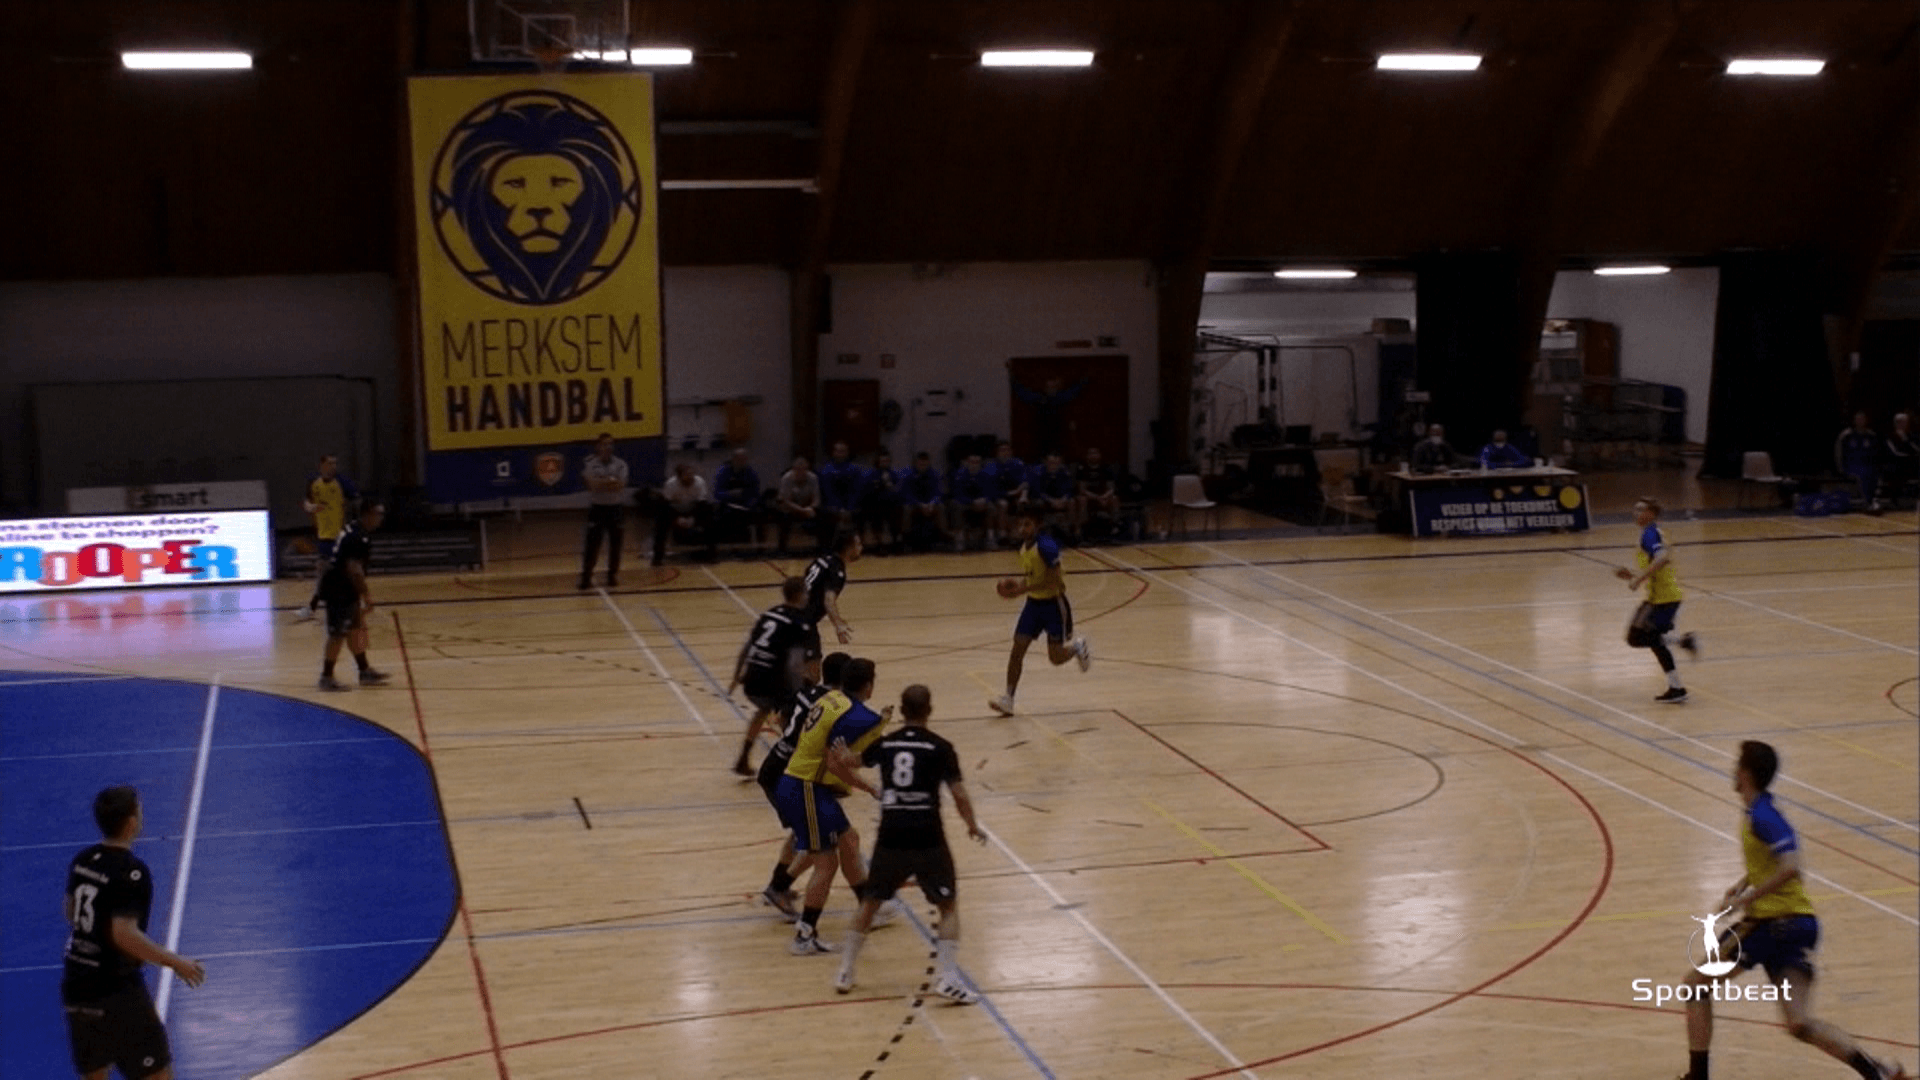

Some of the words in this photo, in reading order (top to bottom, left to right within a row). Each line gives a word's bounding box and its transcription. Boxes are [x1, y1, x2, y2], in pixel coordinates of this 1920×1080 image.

[441, 313, 642, 379] MERKSEM
[446, 377, 644, 432] HANDBAL
[141, 487, 208, 508] smart
[0, 540, 239, 586] ROOPER
[755, 619, 777, 647] 2
[892, 751, 915, 787] 8
[73, 882, 99, 934] 13
